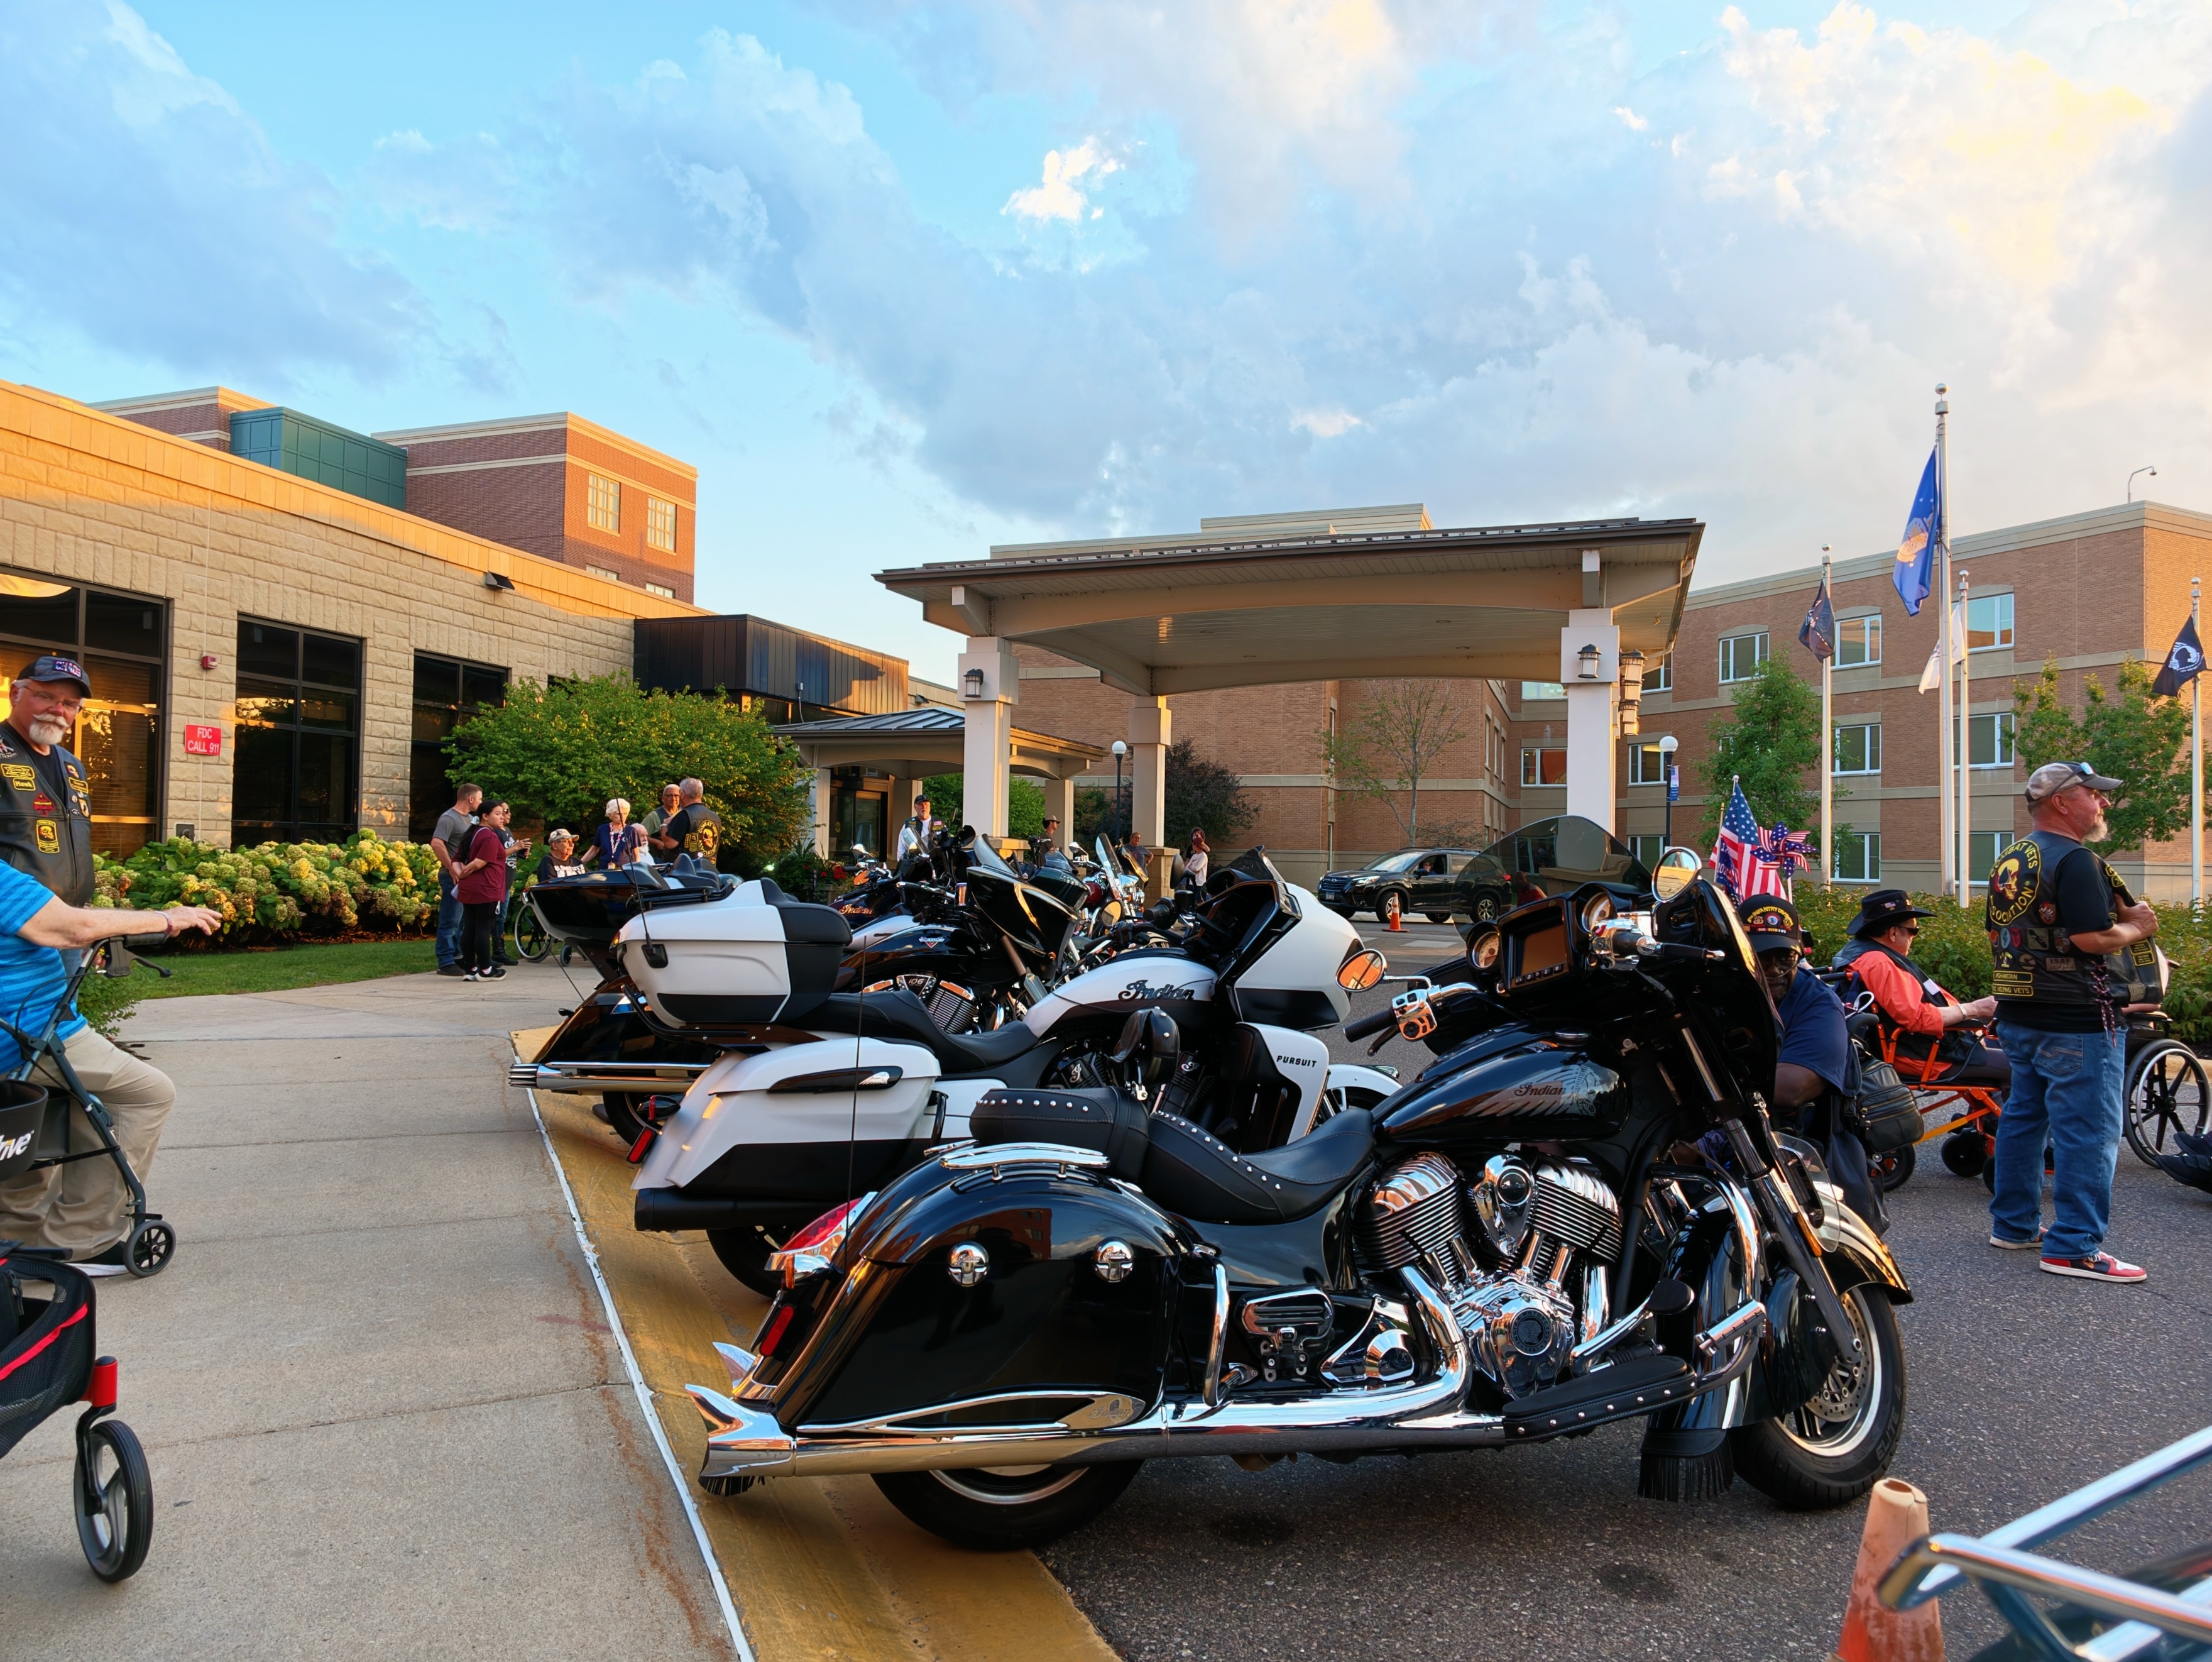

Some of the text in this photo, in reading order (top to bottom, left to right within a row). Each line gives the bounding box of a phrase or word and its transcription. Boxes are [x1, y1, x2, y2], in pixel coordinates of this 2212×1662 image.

[197, 727, 212, 739] FDC
[187, 740, 219, 754] CALL 911
[15, 780, 33, 788] Hawk
[699, 822, 712, 834] COMBAT
[1990, 842, 2039, 878] COMBAT VETS
[839, 904, 873, 915] Indian
[1752, 906, 1778, 917] INFANTRY
[1118, 979, 1195, 1002] Indian
[1276, 1055, 1317, 1067] PURSUIT
[1514, 1082, 1567, 1096] Indian
[1522, 1311, 1550, 1343] MOTORCYCLE
[1089, 1406, 1131, 1419] Indian
[1876, 1405, 1899, 1461] ELITE
